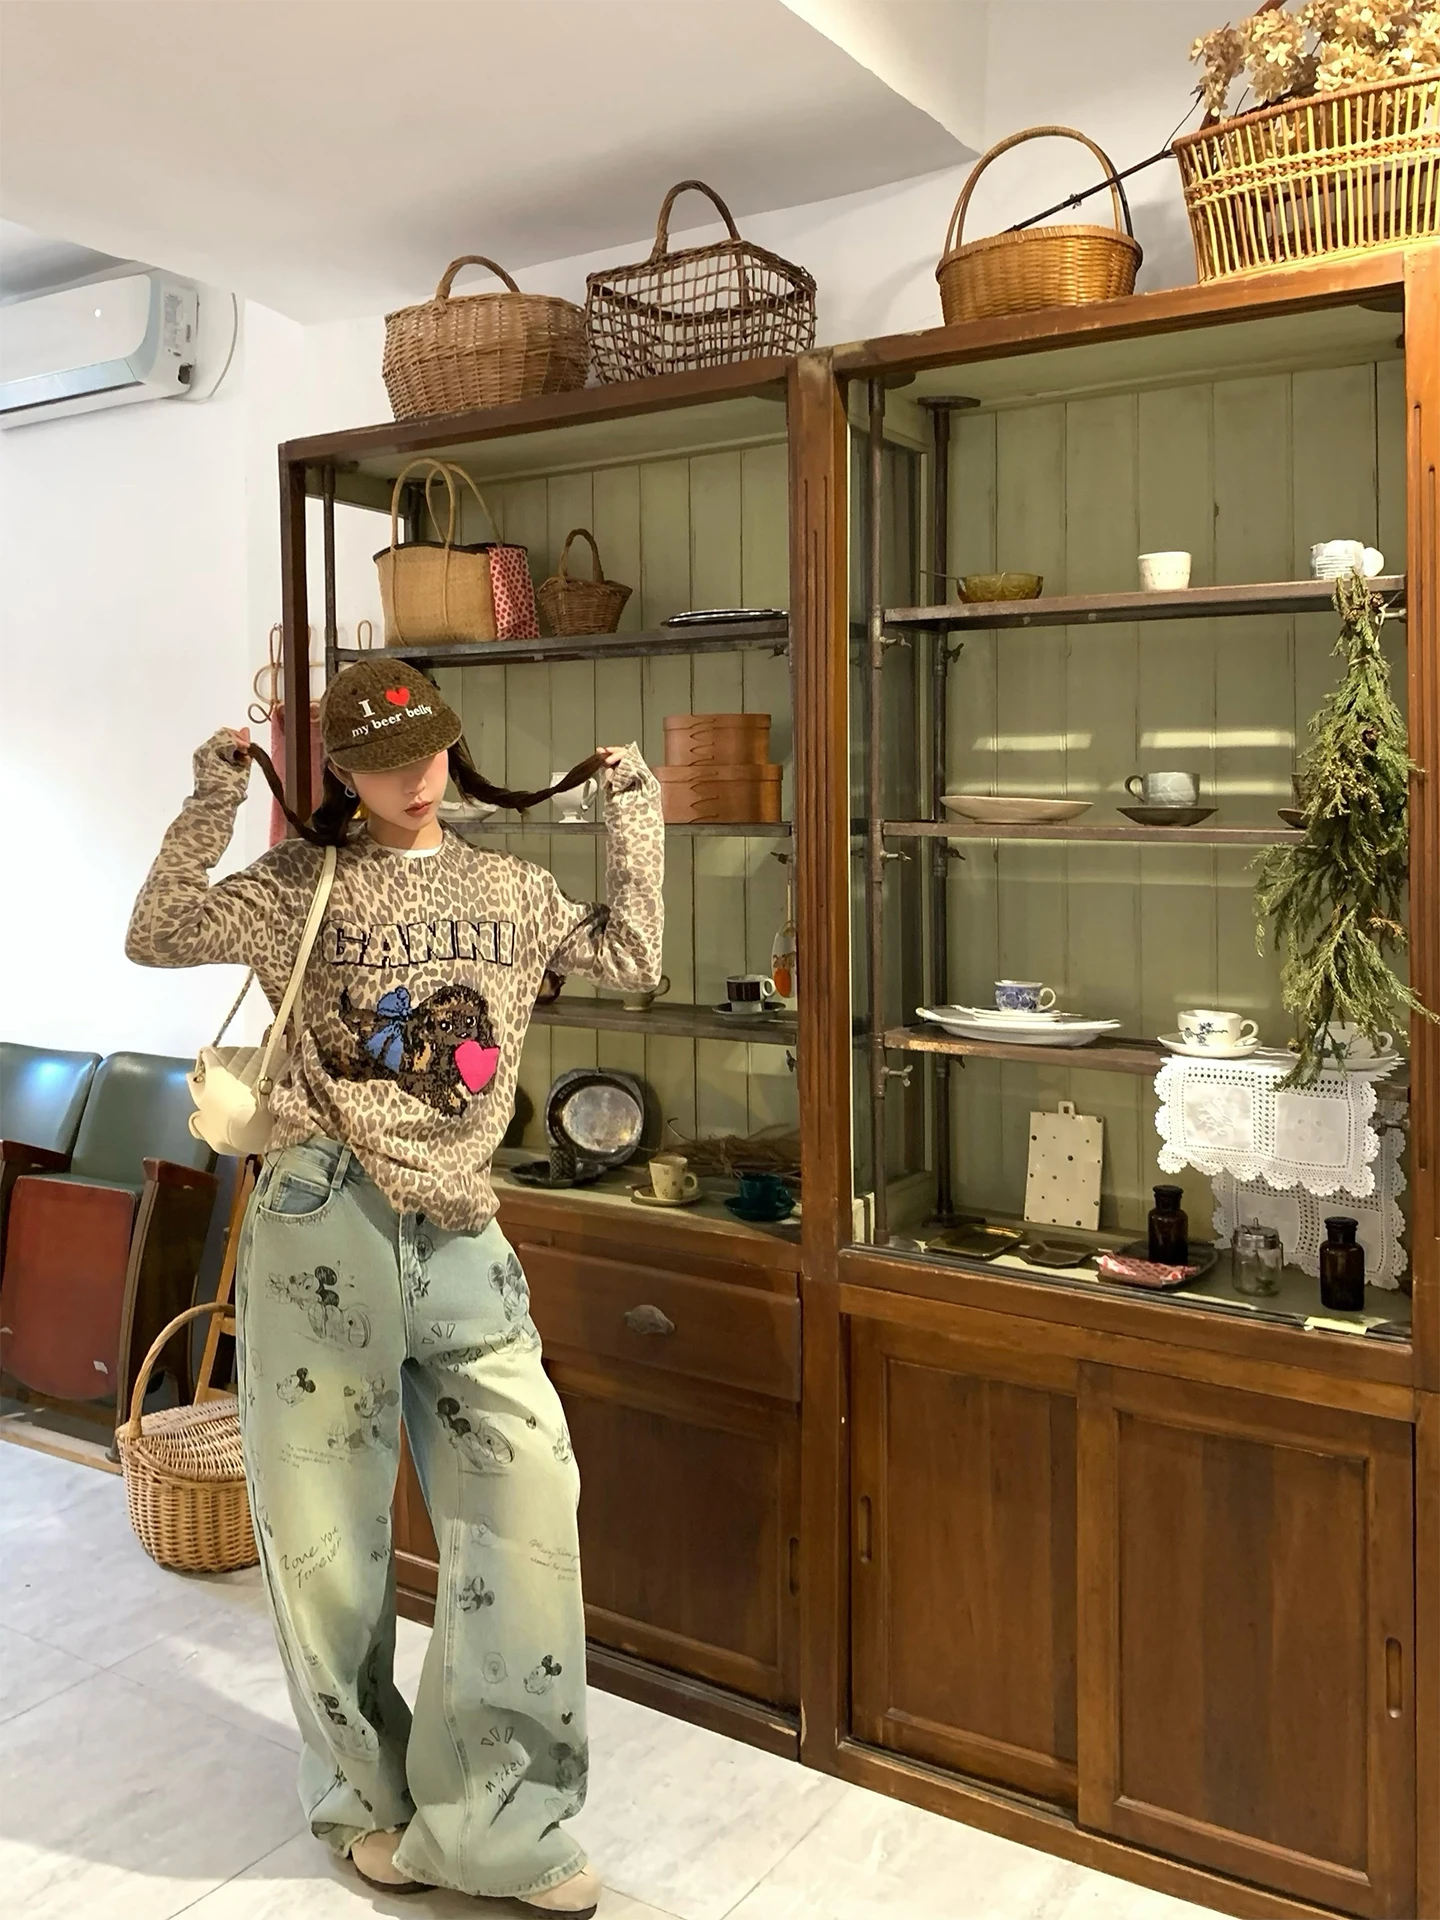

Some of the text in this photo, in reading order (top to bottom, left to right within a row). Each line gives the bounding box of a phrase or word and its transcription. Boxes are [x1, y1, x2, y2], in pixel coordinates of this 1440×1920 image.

[351, 704, 433, 738] my beer belly
[358, 699, 376, 718] I
[321, 918, 516, 968] GANNI
